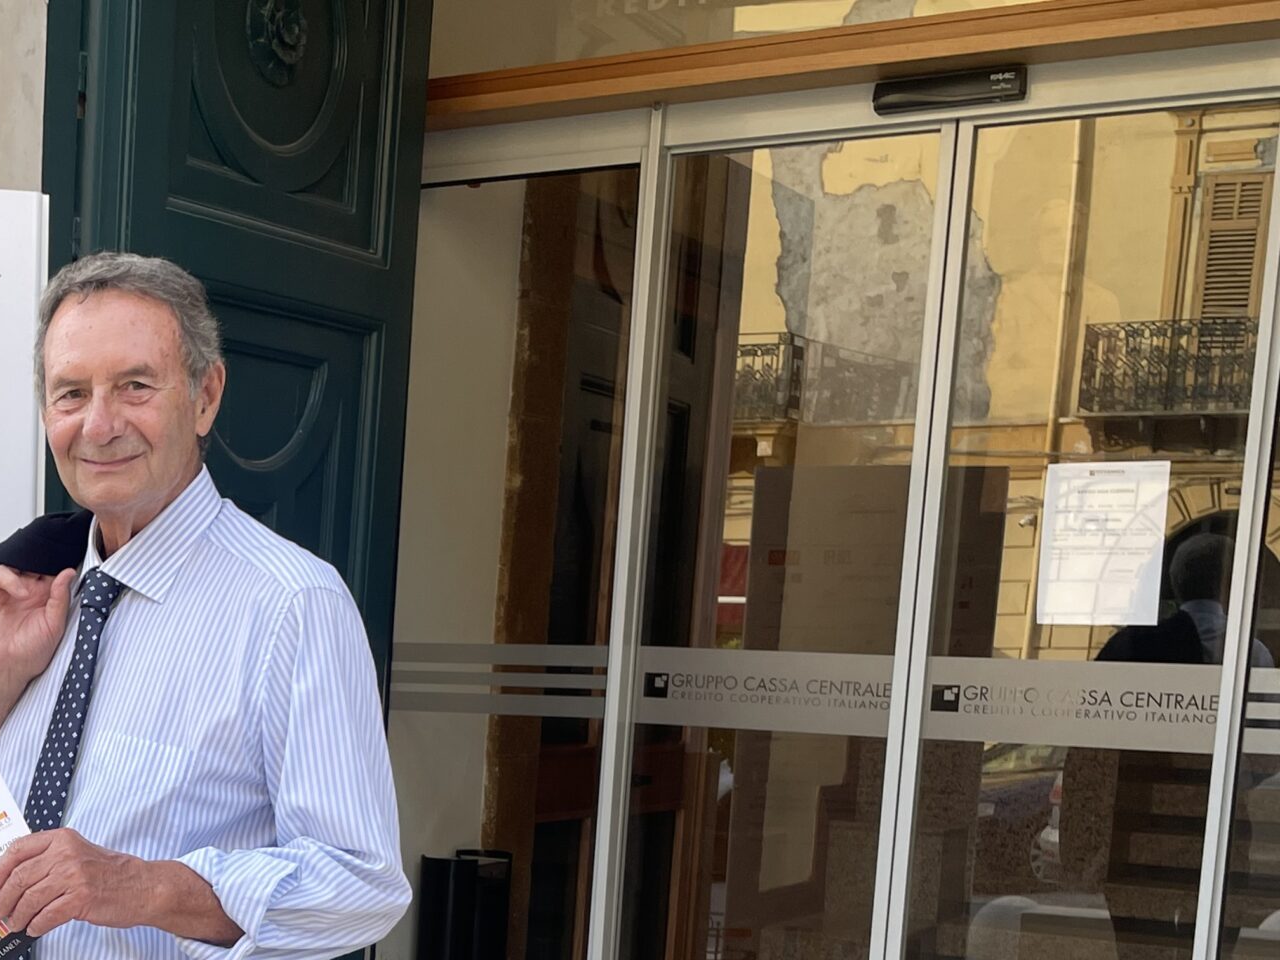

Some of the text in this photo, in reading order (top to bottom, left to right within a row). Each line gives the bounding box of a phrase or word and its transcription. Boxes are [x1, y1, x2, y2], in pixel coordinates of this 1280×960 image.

[671, 673, 892, 699] GRUPPO CASSA CENTRALE
[671, 690, 891, 711] CREDITO COOPERATIVO ITALIANO
[1120, 690, 1220, 712] CENTRALE
[1144, 710, 1218, 725] ITALIANO
